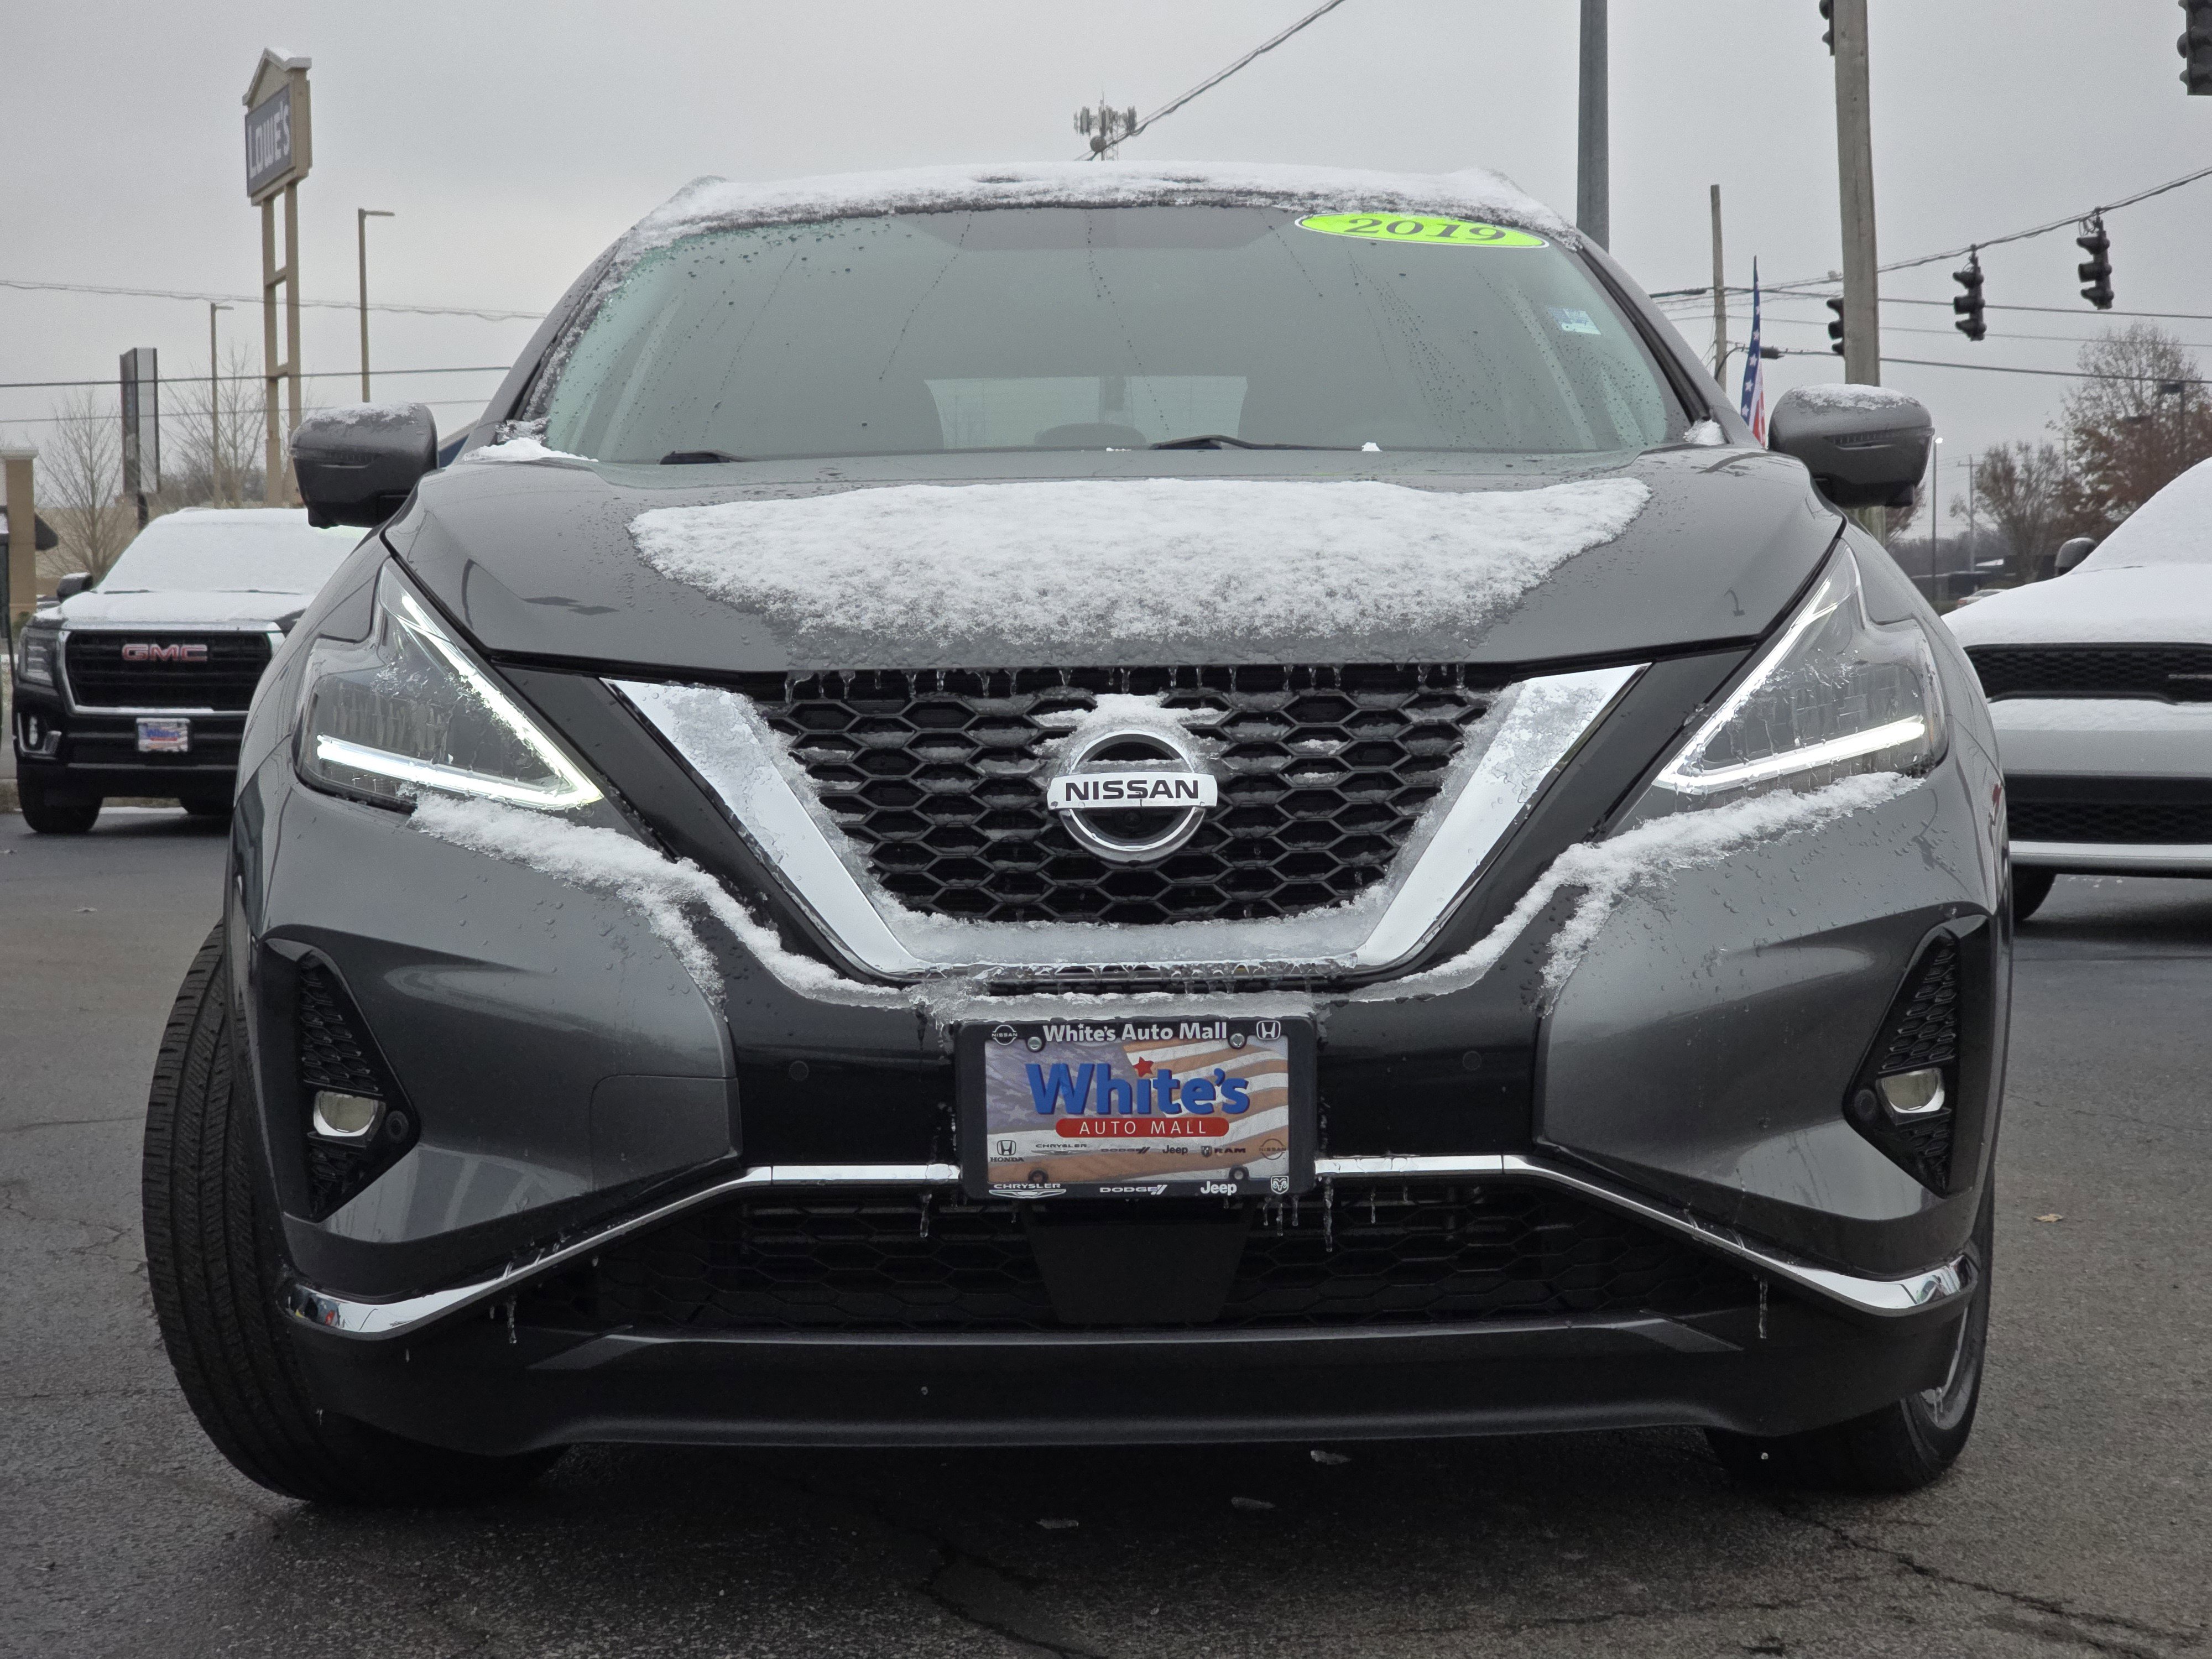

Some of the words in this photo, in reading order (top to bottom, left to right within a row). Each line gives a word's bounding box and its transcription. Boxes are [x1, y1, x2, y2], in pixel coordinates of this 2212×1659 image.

[249, 100, 290, 180] LOWE'S
[1344, 218, 1506, 241] 2019
[122, 643, 208, 662] GMC
[1065, 780, 1199, 801] NISSAN
[1042, 1024, 1116, 1042] White's
[1121, 1024, 1173, 1040] Auto
[1180, 1022, 1227, 1039] Mall
[1025, 1057, 1250, 1115] White's
[1079, 1120, 1136, 1135] AUTO
[1150, 1120, 1206, 1134] MALL
[1162, 1145, 1188, 1155] Jeep
[1201, 1181, 1237, 1196] Jeep
